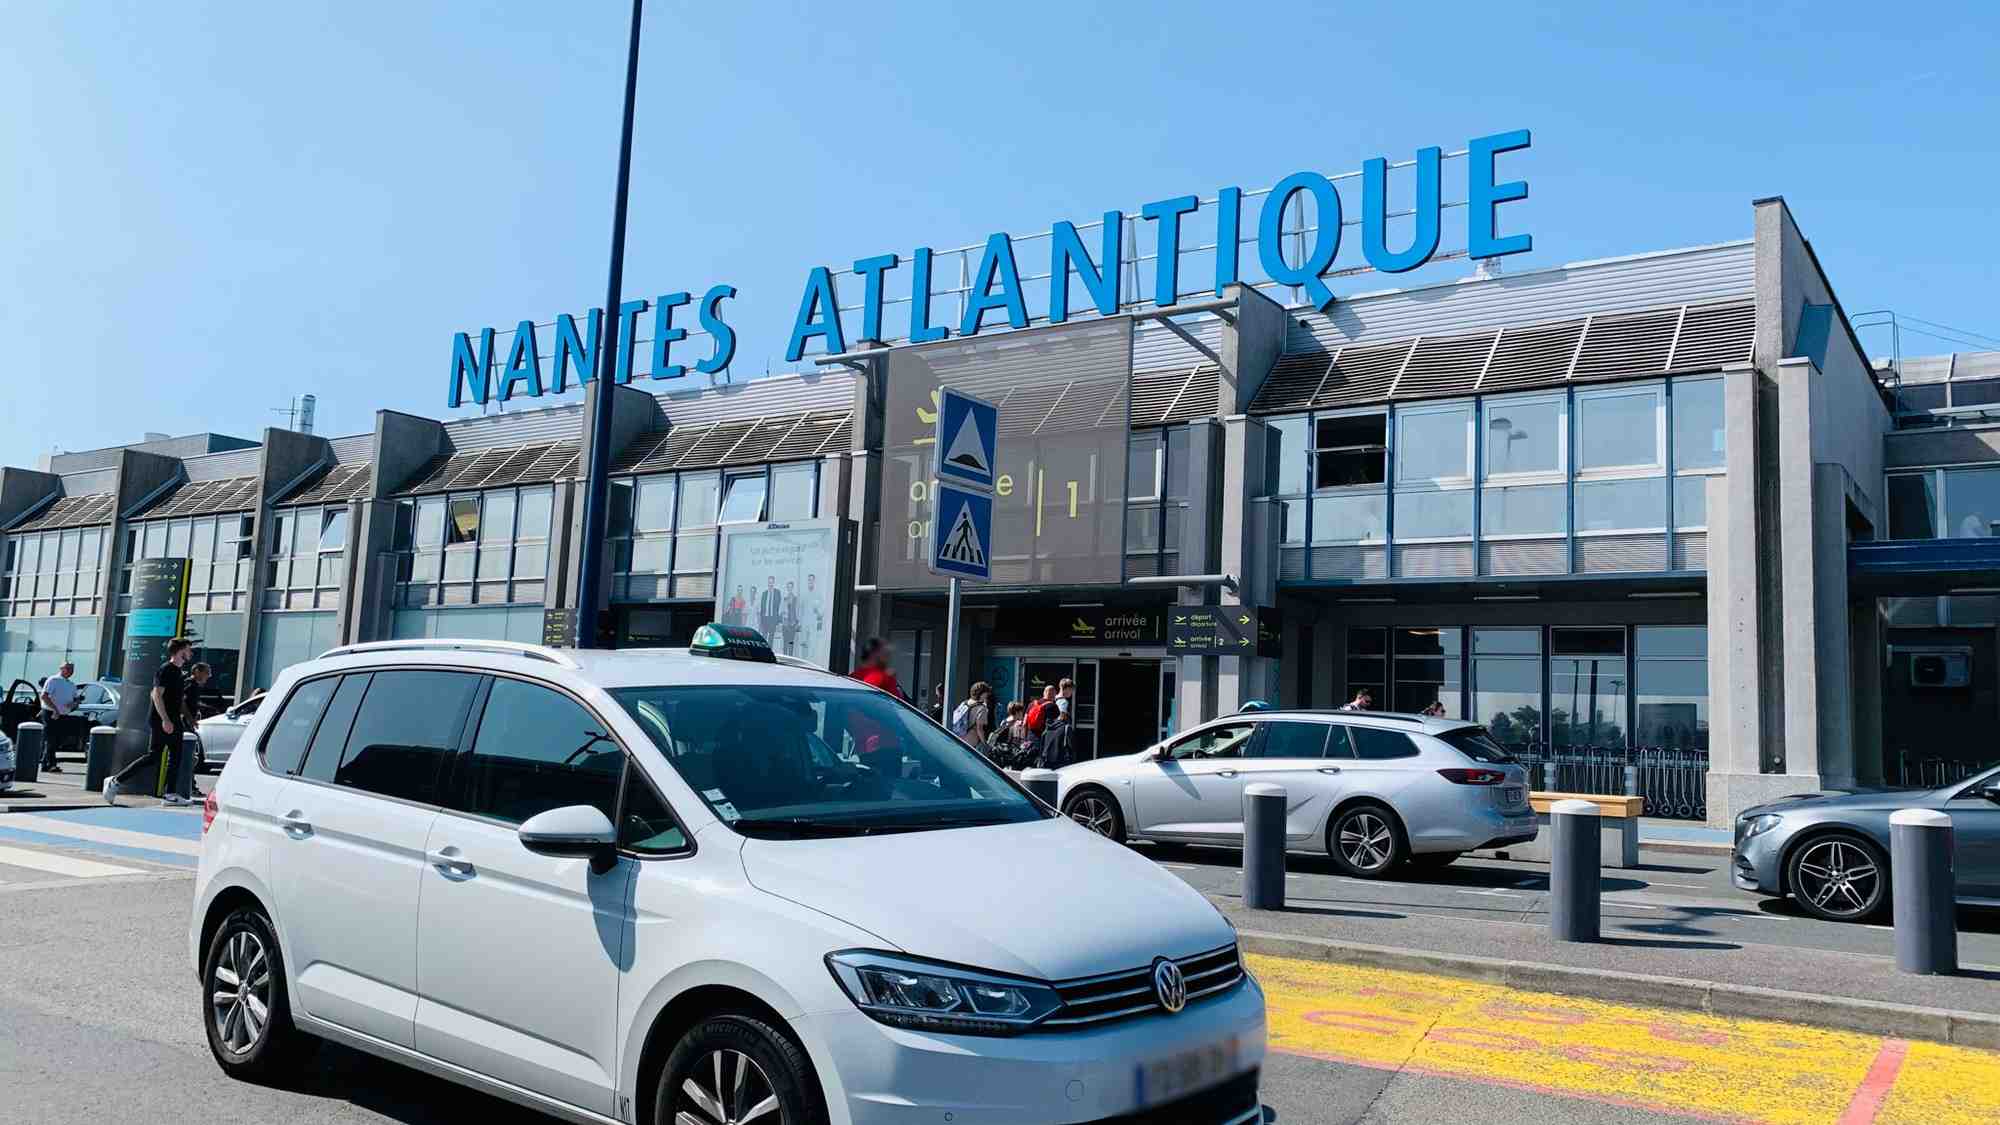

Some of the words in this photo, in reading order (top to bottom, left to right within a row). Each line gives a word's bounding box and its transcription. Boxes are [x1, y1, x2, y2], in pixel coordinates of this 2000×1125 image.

[448, 284, 737, 408] NANTES
[785, 129, 1532, 362] ATLANTIQUE
[1067, 481, 1078, 518] 1
[1104, 614, 1147, 626] arrivée
[1104, 628, 1141, 640] arrival
[1217, 637, 1225, 646] 2
